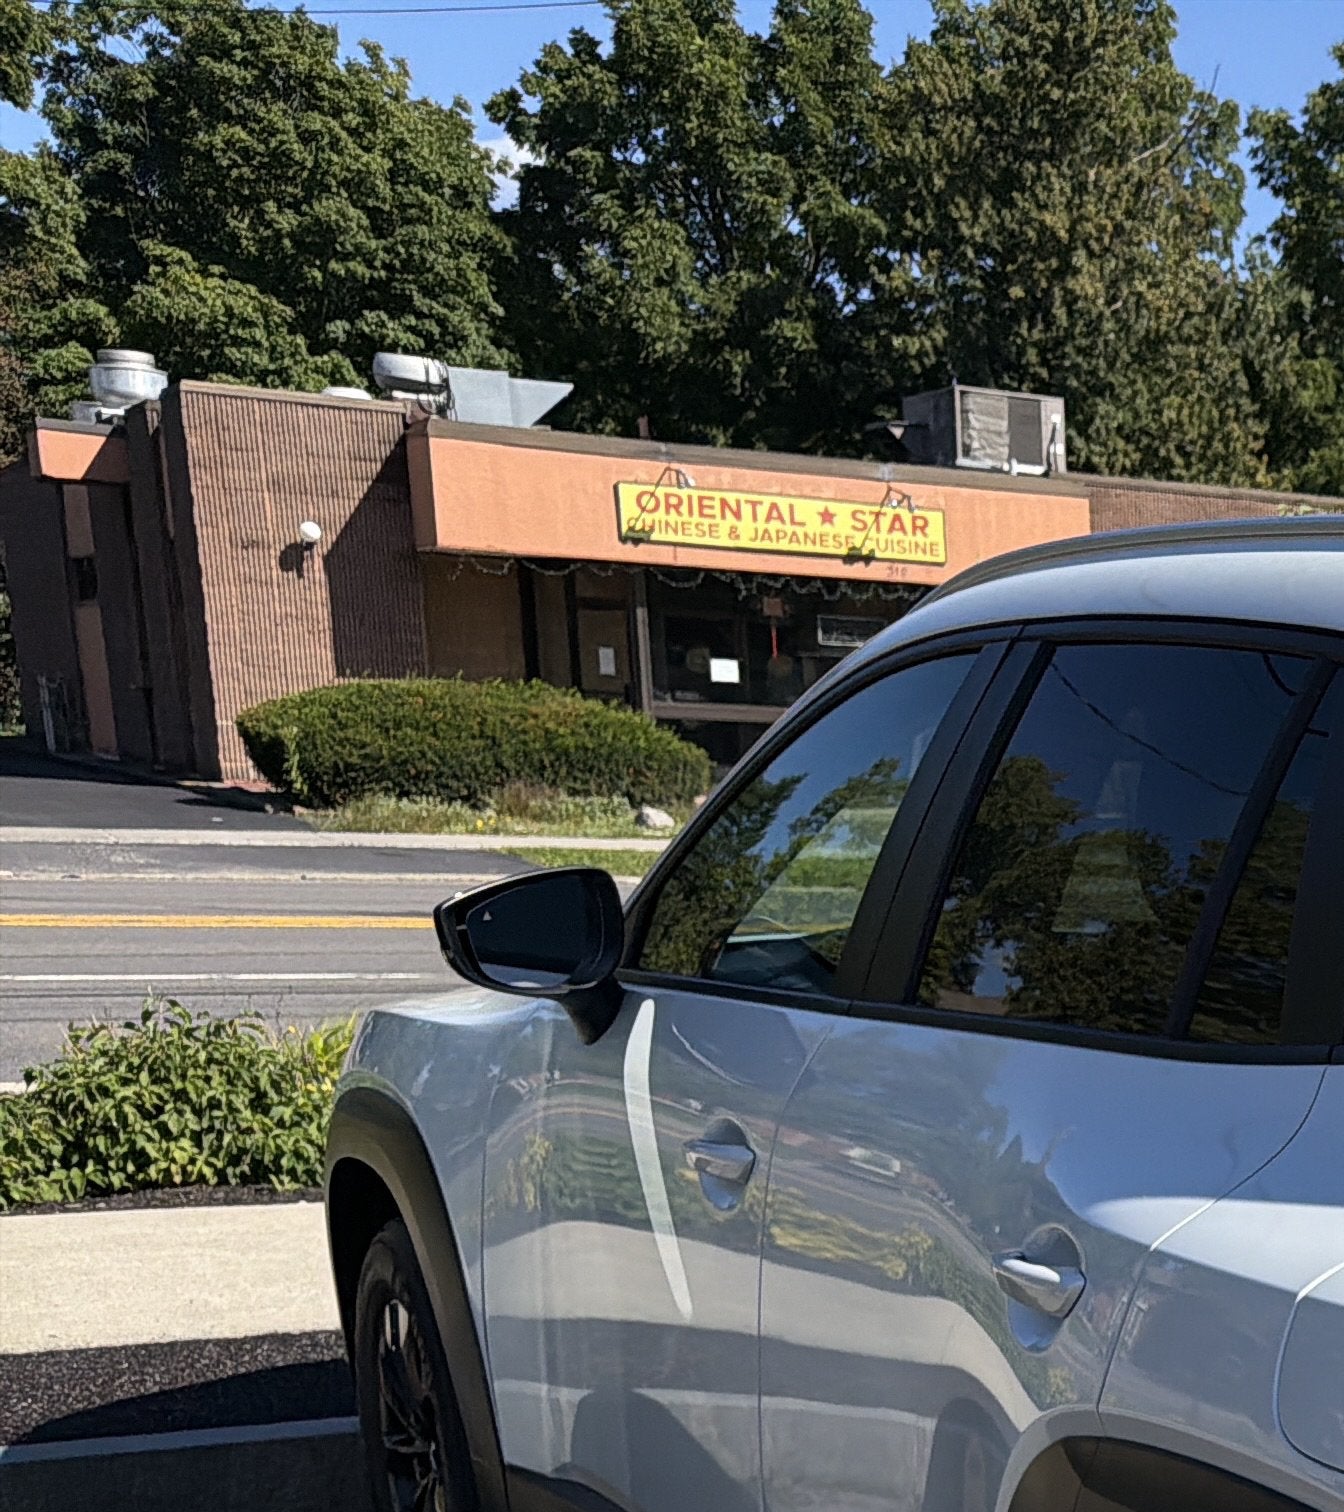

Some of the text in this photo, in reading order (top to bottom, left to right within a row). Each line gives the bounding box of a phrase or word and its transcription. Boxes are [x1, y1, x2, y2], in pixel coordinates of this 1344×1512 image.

[635, 490, 930, 538] ORIENTAL STAR
[728, 525, 741, 541] &
[749, 527, 857, 550] JAPANESE
